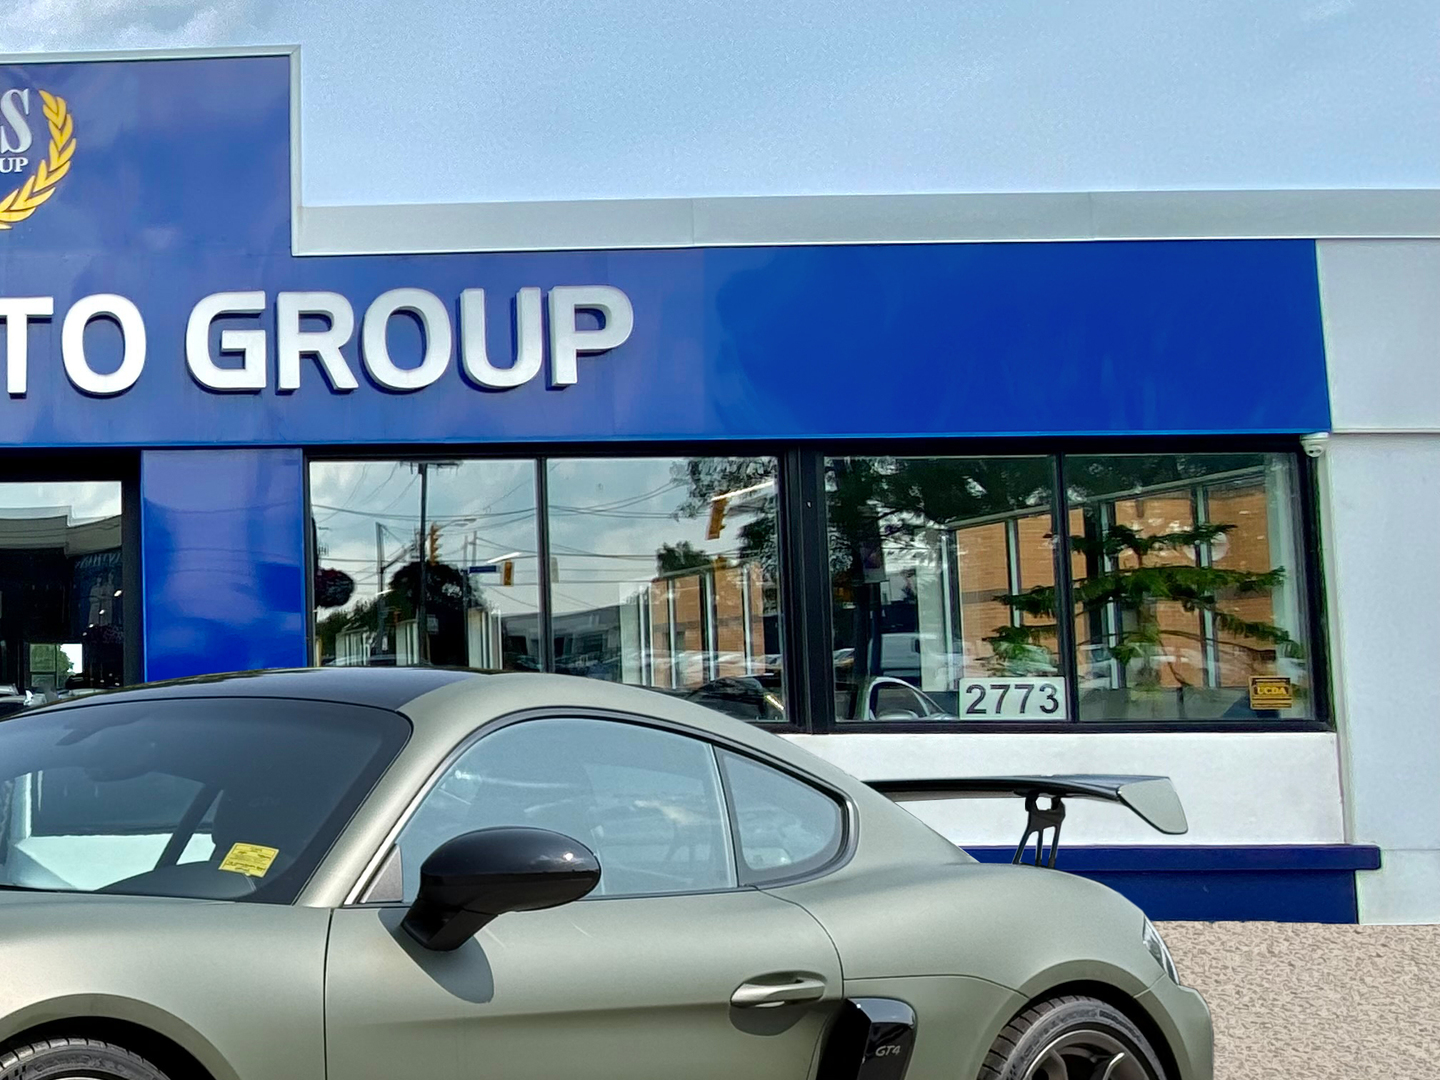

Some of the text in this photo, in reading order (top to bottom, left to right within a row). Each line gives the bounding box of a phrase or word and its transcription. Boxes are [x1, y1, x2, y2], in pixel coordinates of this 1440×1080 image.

[185, 285, 635, 393] GROUP
[965, 684, 1060, 714] 2773
[875, 1045, 901, 1057] GT4
